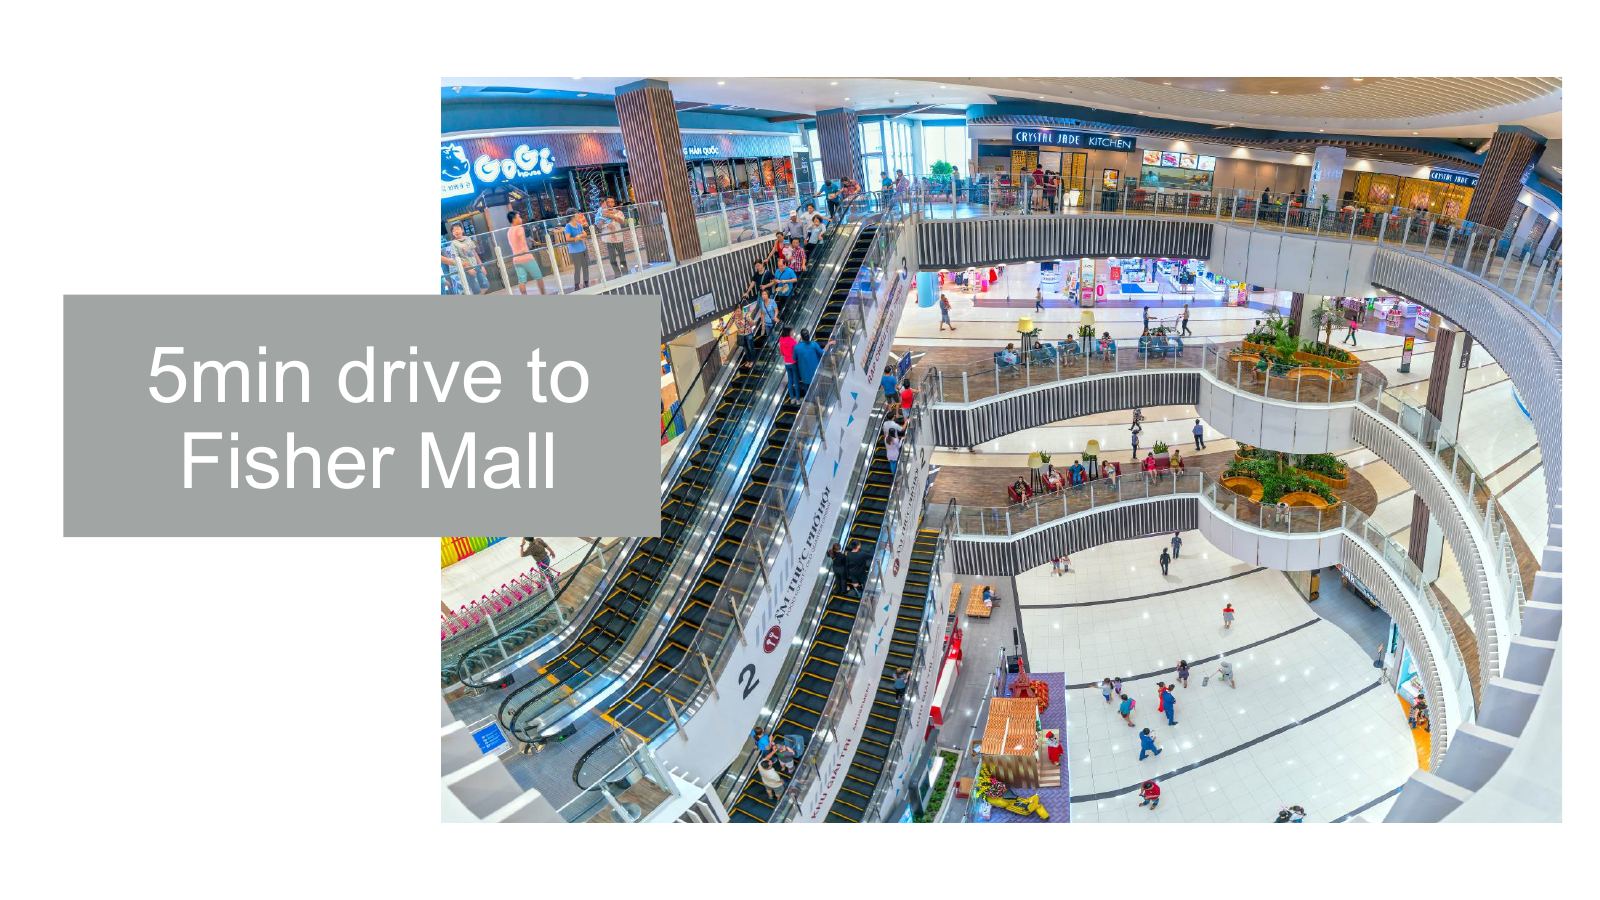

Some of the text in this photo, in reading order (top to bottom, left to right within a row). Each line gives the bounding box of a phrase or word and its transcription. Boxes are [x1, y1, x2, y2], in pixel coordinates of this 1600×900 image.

[1016, 131, 1132, 149] CRYSTAL JADE KITCHEN
[738, 663, 760, 700] 2
[810, 793, 828, 819] KHU
[853, 683, 871, 731] AMUSEMENT
